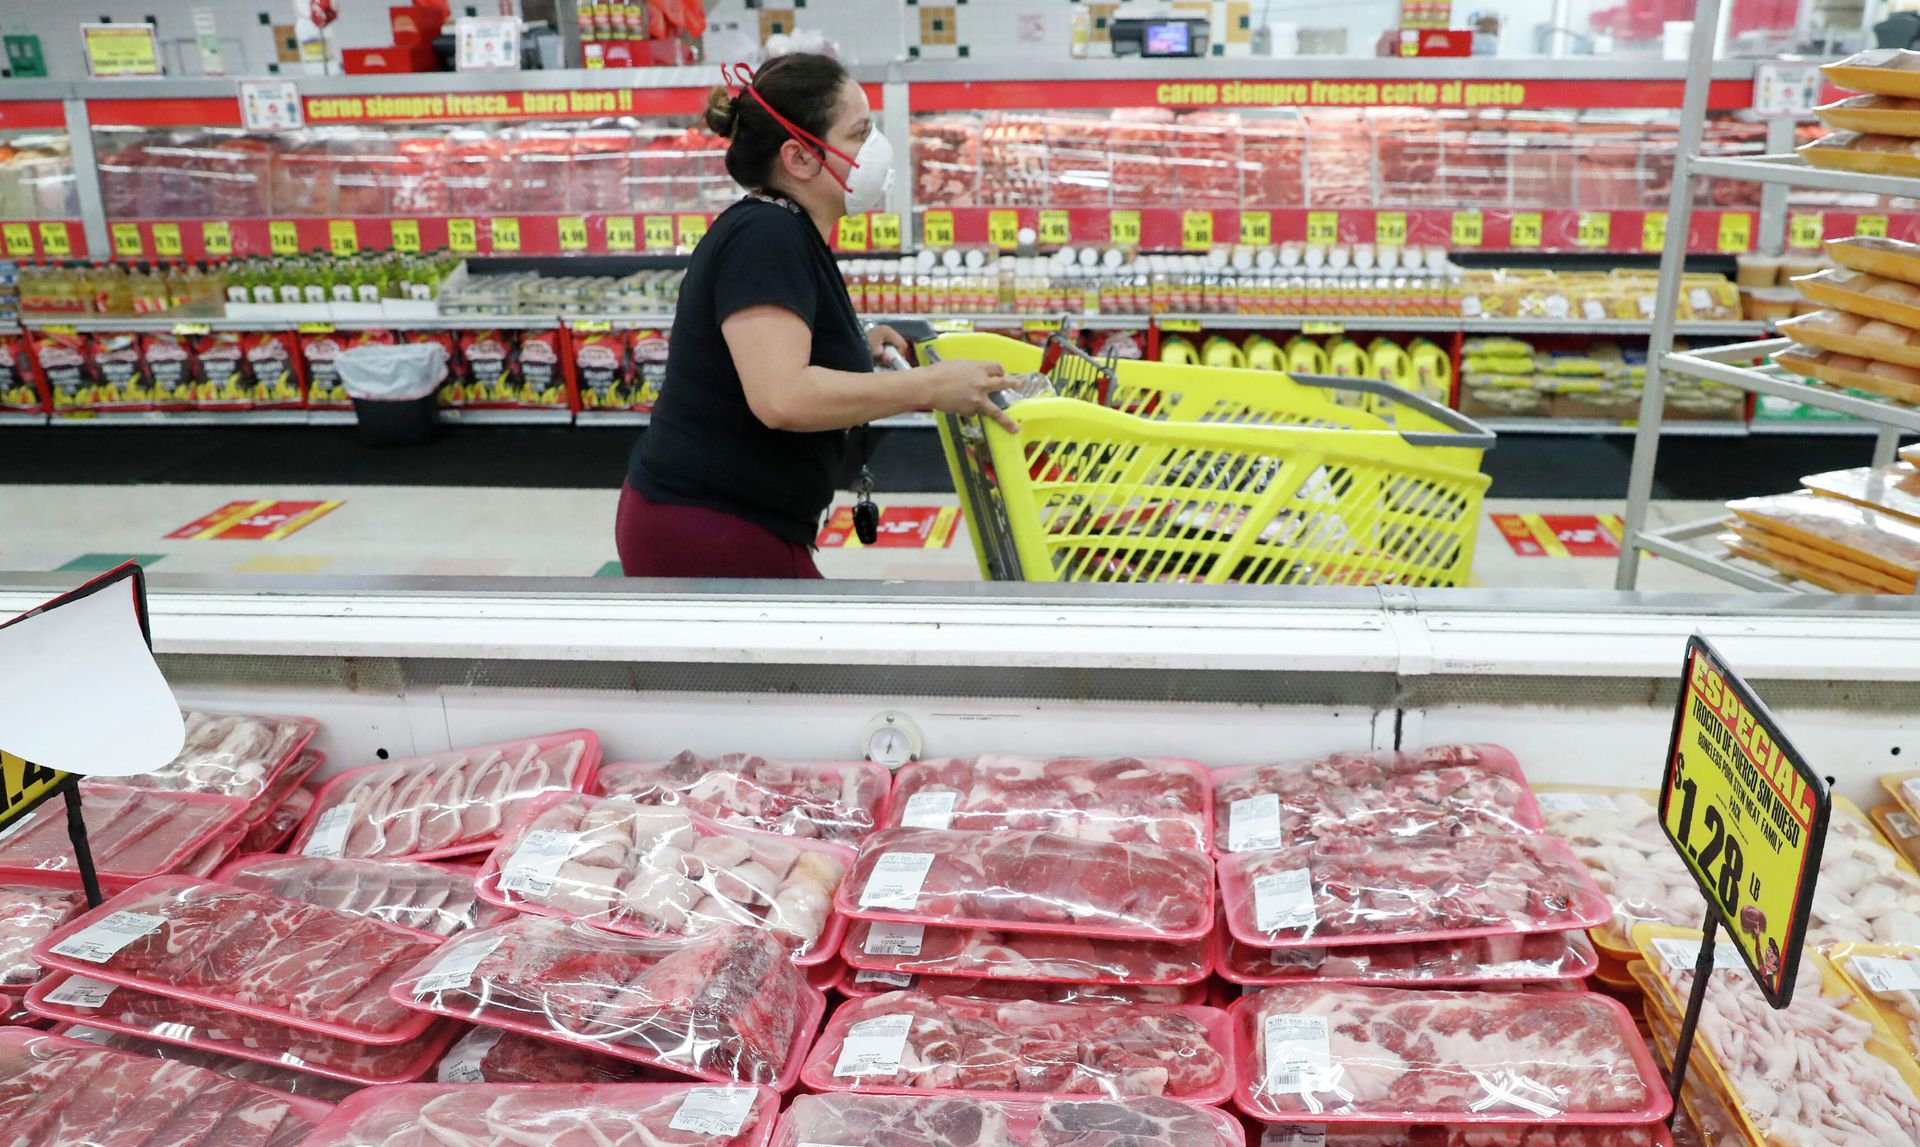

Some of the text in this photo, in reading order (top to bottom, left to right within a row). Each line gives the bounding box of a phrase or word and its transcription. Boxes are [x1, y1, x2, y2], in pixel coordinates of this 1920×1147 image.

[307, 97, 363, 119] carne
[366, 94, 445, 119] siempre
[523, 90, 568, 114] bara
[570, 89, 616, 113] bara
[1157, 79, 1526, 107] carne siempre fresca corte al gusto
[1691, 652, 1812, 824] ESPECIAL
[1692, 695, 1801, 850] TROCITO DE PUERCO SIN HUESO
[1697, 731, 1722, 769] BONELESS
[1721, 755, 1734, 785] PORK
[1733, 780, 1747, 808] STEW
[1745, 793, 1760, 823] MEAT
[1760, 816, 1784, 856] FAMILY
[1729, 795, 1742, 820] PACK
[1749, 872, 1761, 902] LB
